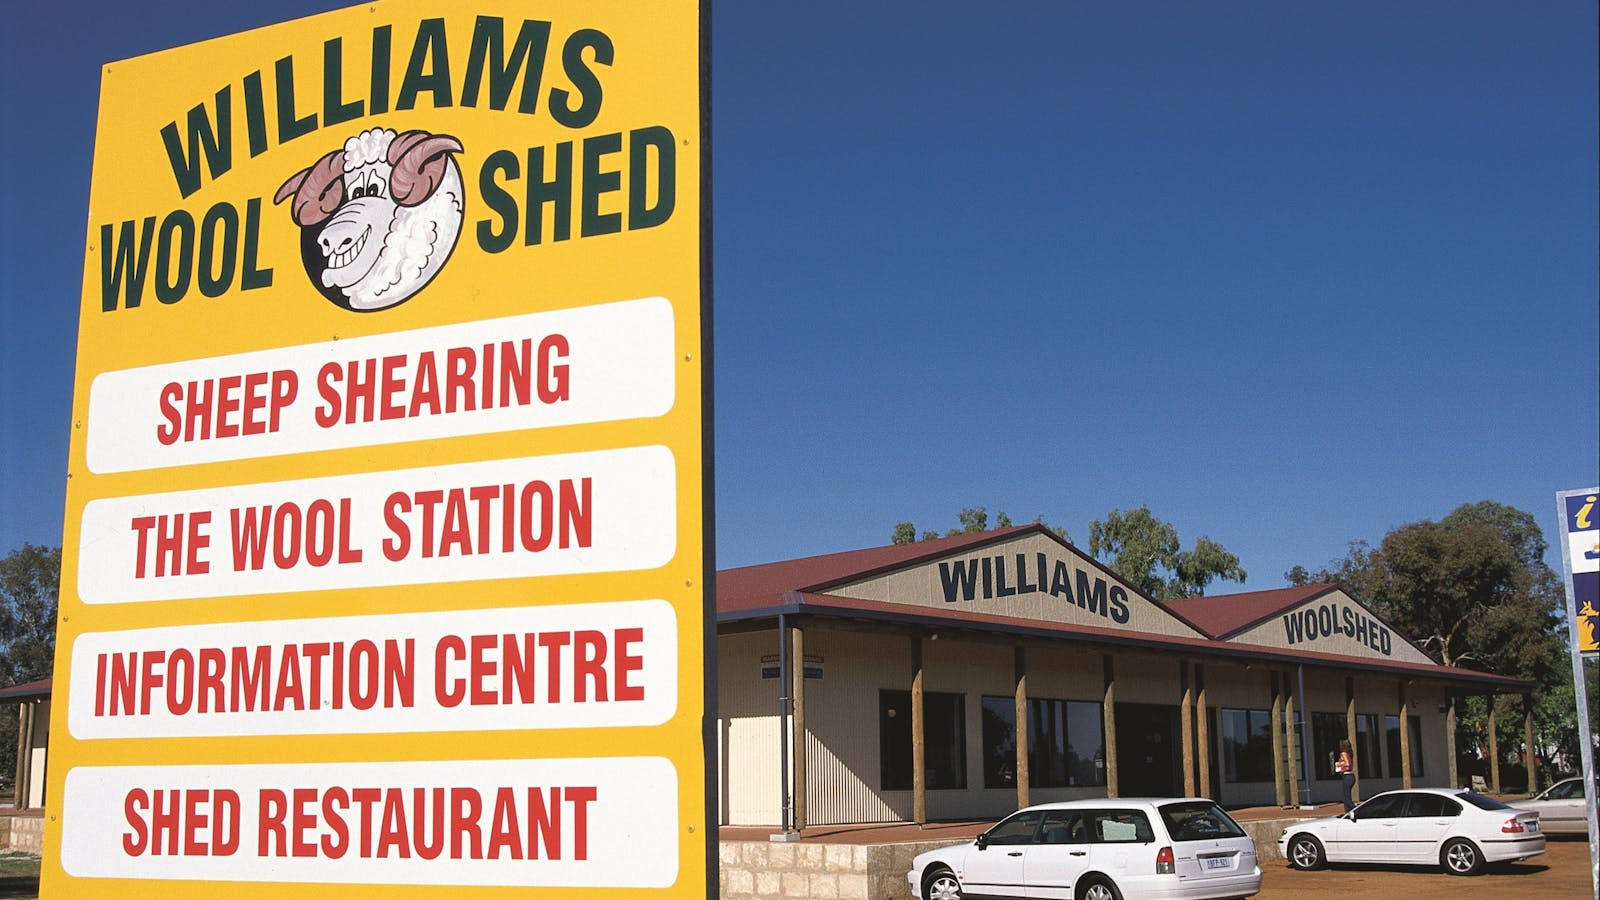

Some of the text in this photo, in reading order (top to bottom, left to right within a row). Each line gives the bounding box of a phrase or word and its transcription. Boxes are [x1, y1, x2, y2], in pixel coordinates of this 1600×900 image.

[160, 15, 615, 199] WILLIAMS
[101, 125, 676, 313] WOOL SHED
[158, 334, 569, 445] SHEEP SHEARING
[132, 478, 592, 578] THE WOOL STATION
[938, 552, 1130, 624] WILLIAMS
[1283, 603, 1392, 657] WOOLSHED
[96, 628, 645, 717] INFORMATION CENTRE
[124, 786, 597, 861] SHED RESTAURANT
